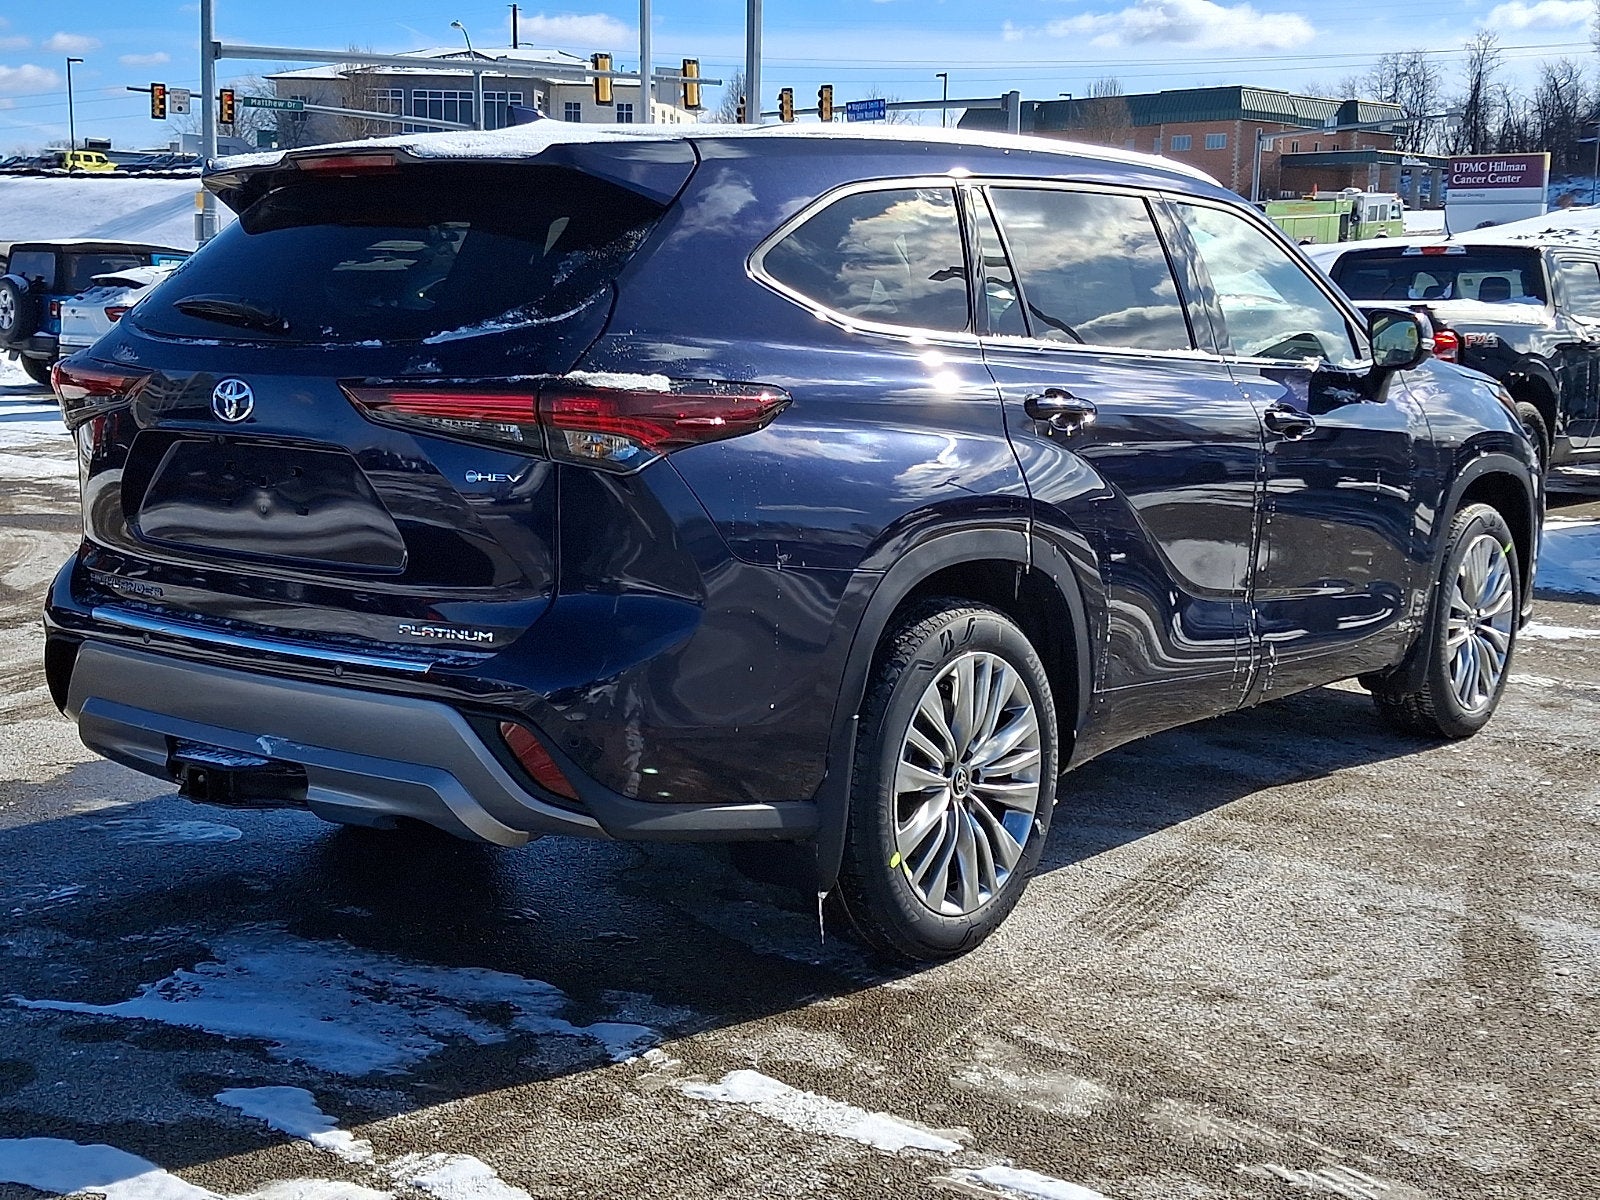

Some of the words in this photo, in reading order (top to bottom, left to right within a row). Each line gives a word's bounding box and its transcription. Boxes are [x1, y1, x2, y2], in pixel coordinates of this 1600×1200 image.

[250, 98, 284, 109] Matthew
[287, 101, 296, 109] Dr
[1454, 162, 1487, 173] UPMC
[1488, 161, 1527, 172] Hillman
[1452, 174, 1486, 184] Cancer
[1487, 173, 1521, 183] Center
[1463, 332, 1499, 348] FX4
[477, 473, 523, 483] HEV
[398, 624, 494, 642] PLATINUM
